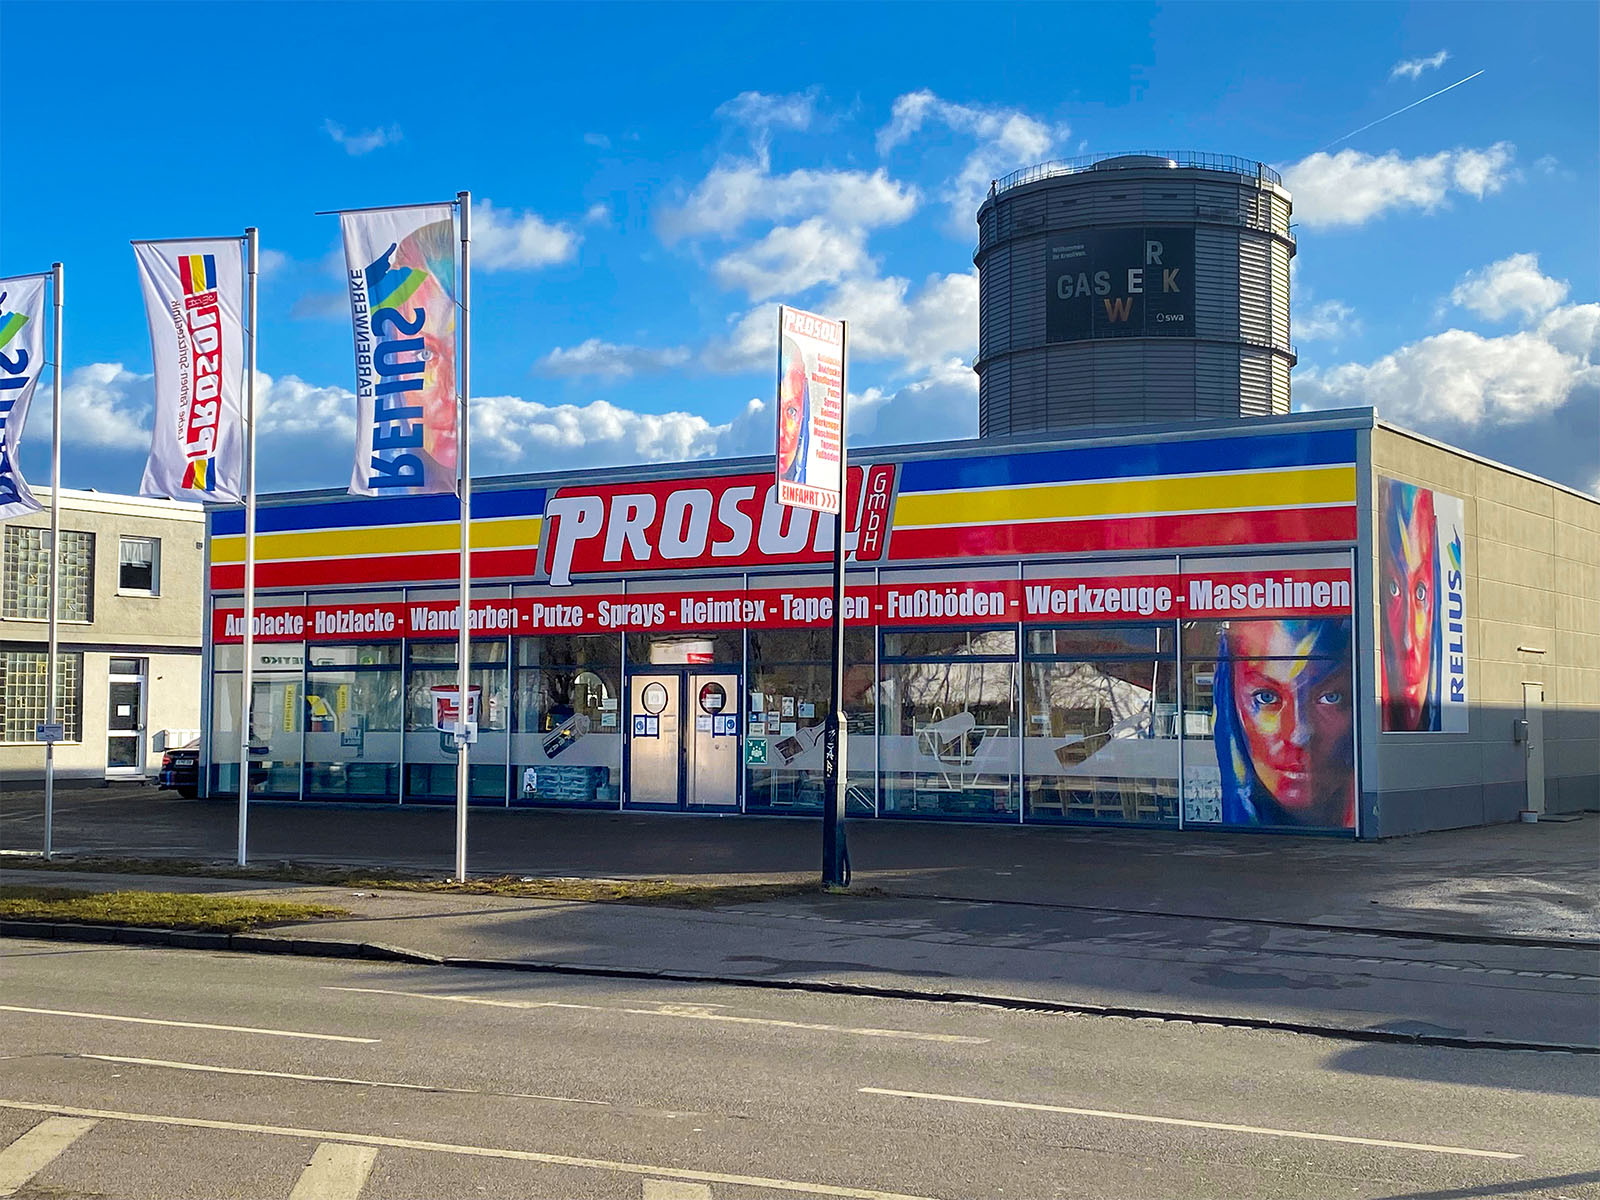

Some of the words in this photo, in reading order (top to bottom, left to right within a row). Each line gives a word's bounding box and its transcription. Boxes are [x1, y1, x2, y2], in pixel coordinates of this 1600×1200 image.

[1165, 314, 1184, 322] swa
[782, 485, 819, 505] EINFAHRT
[864, 472, 887, 551] GmbH
[225, 612, 304, 636] Auolacke
[315, 608, 395, 634] Holzlacke
[411, 605, 518, 631] Wandarben
[532, 603, 583, 628] Putze
[598, 600, 665, 629] Sprays
[681, 597, 766, 624] Heimtex
[781, 594, 869, 620] Tapeen
[887, 589, 1005, 619] Fußböden
[1025, 584, 1172, 616] Werkzeuge
[1190, 577, 1351, 611] Maschinen
[1448, 570, 1465, 703] RELIUS
